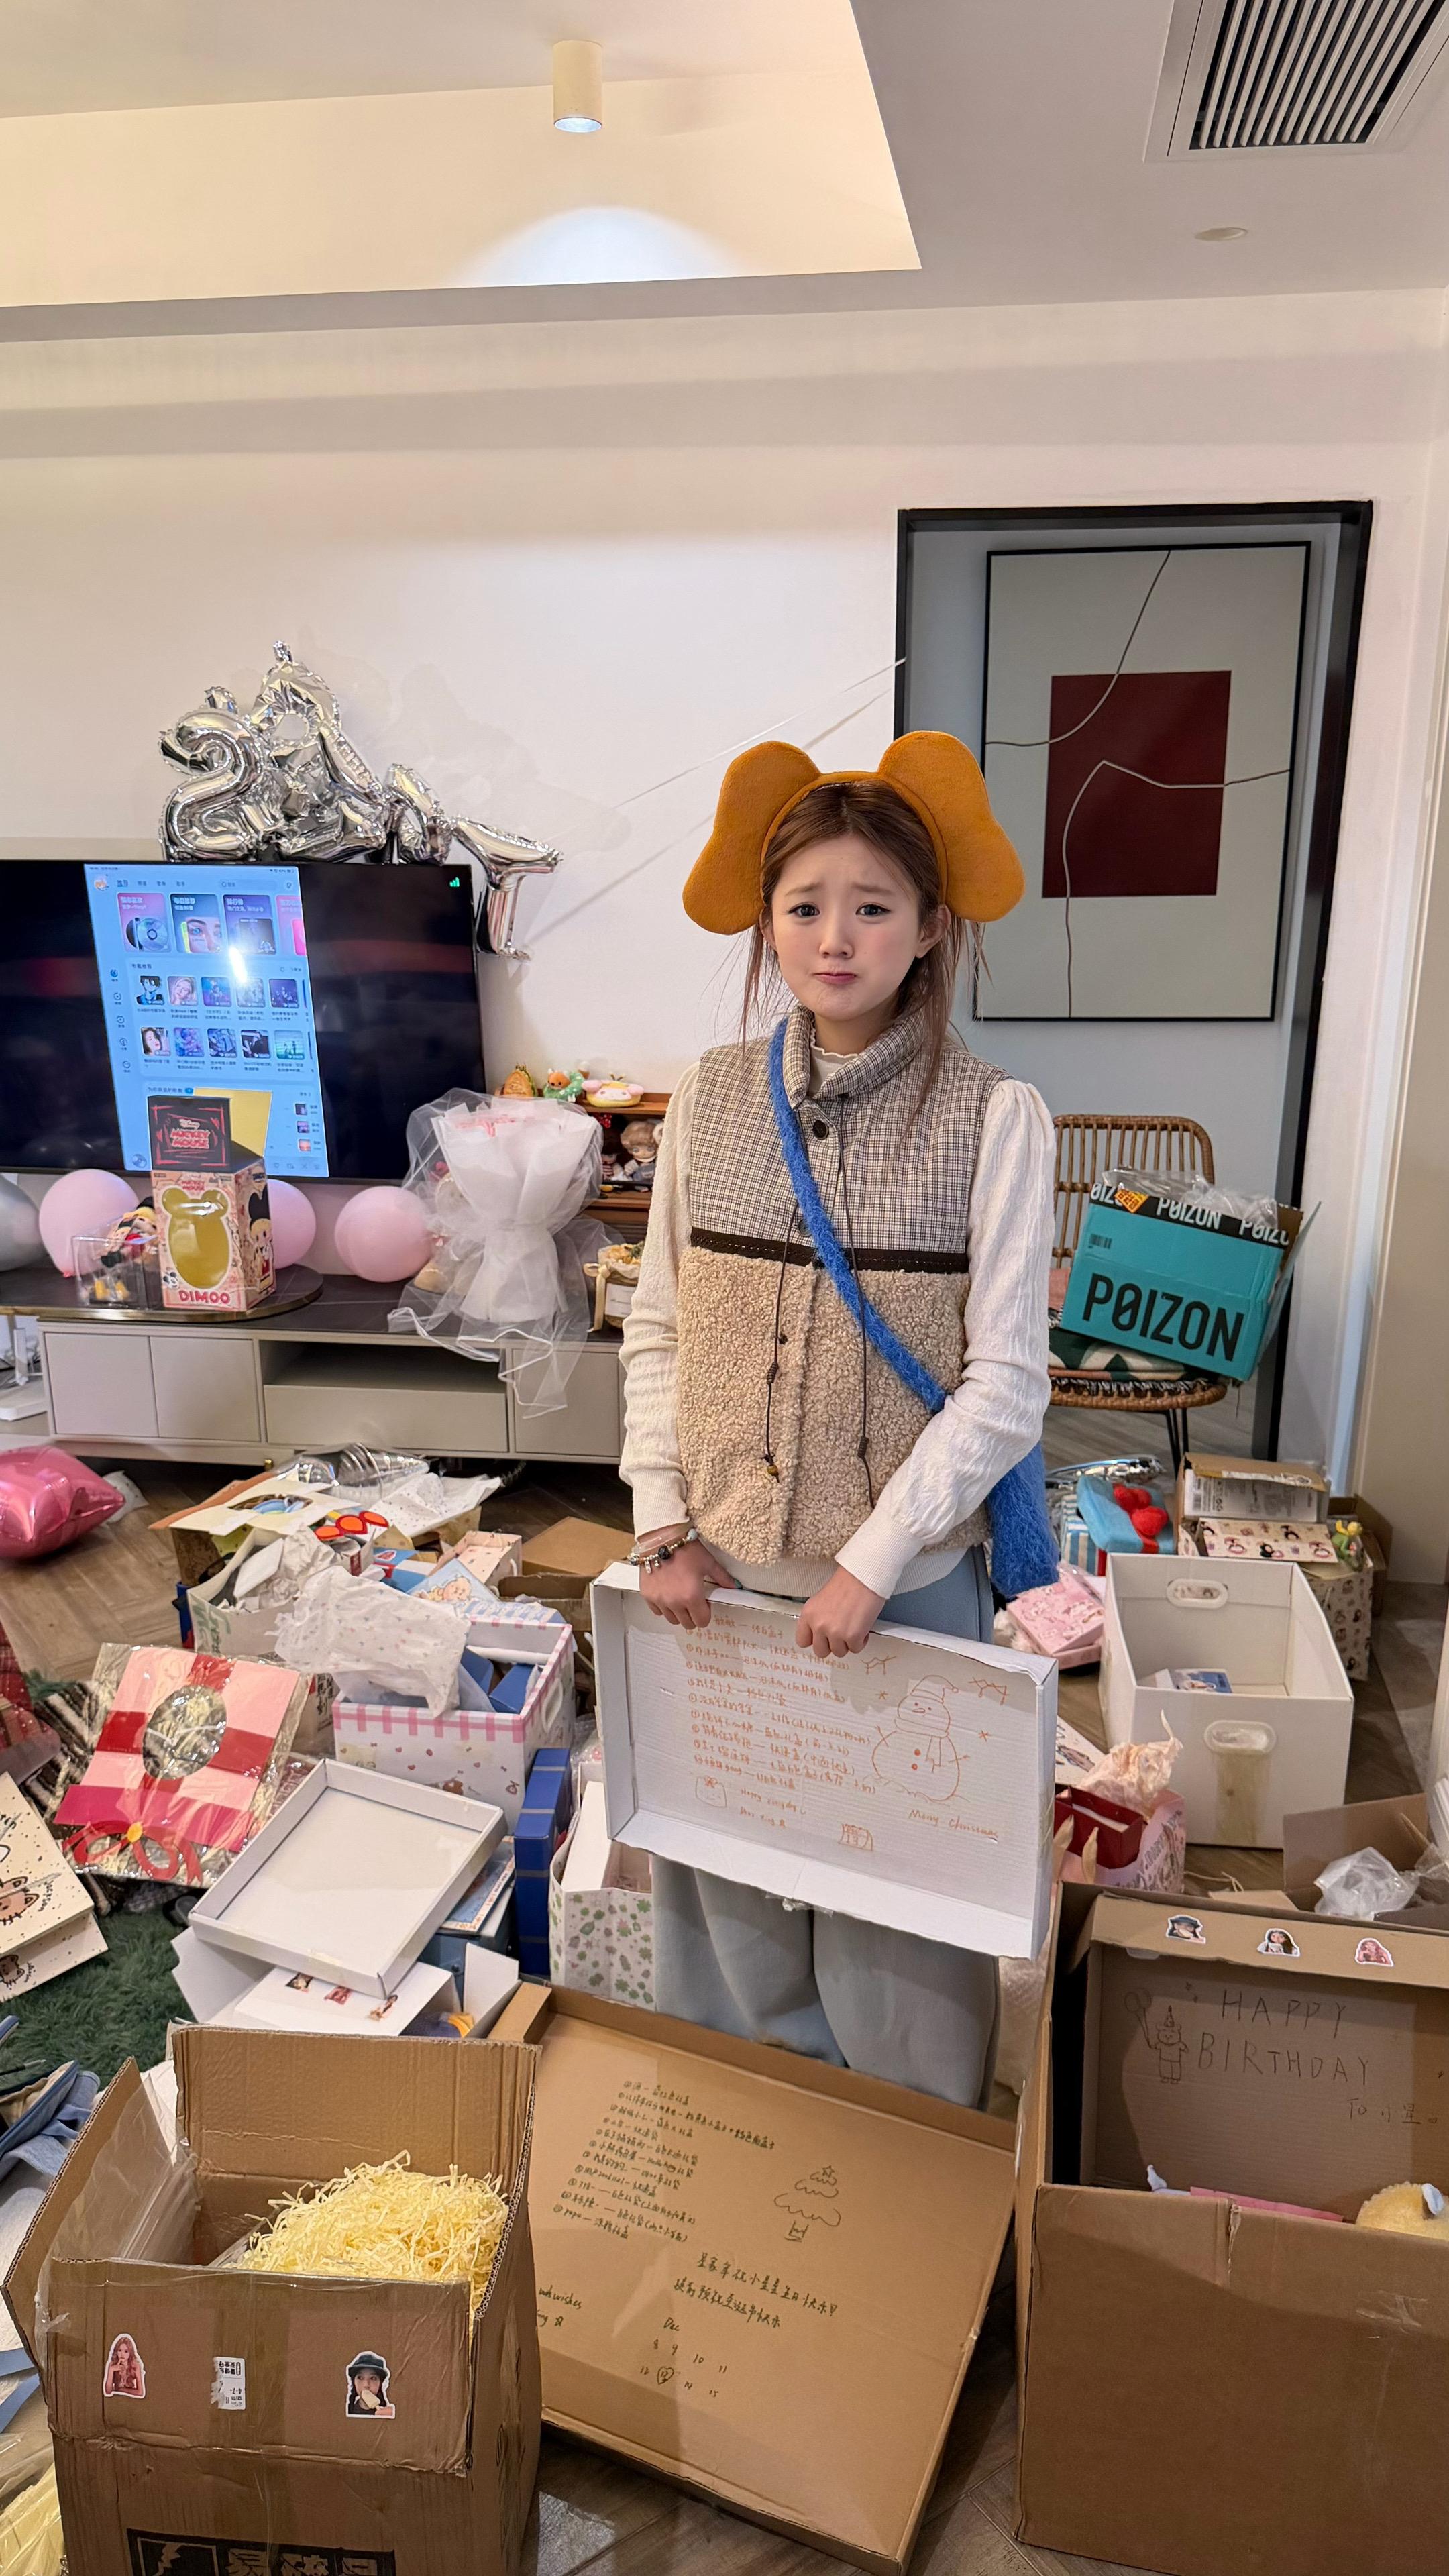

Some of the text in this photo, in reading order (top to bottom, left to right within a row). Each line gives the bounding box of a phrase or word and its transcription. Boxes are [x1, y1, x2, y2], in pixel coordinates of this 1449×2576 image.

[178, 1290, 231, 1304] DIMOO
[1221, 1990, 1346, 2039] HAPPY
[1198, 2032, 1369, 2086] BIRTHDAY
[672, 2344, 678, 2355] 9
[693, 2353, 704, 2363] 10
